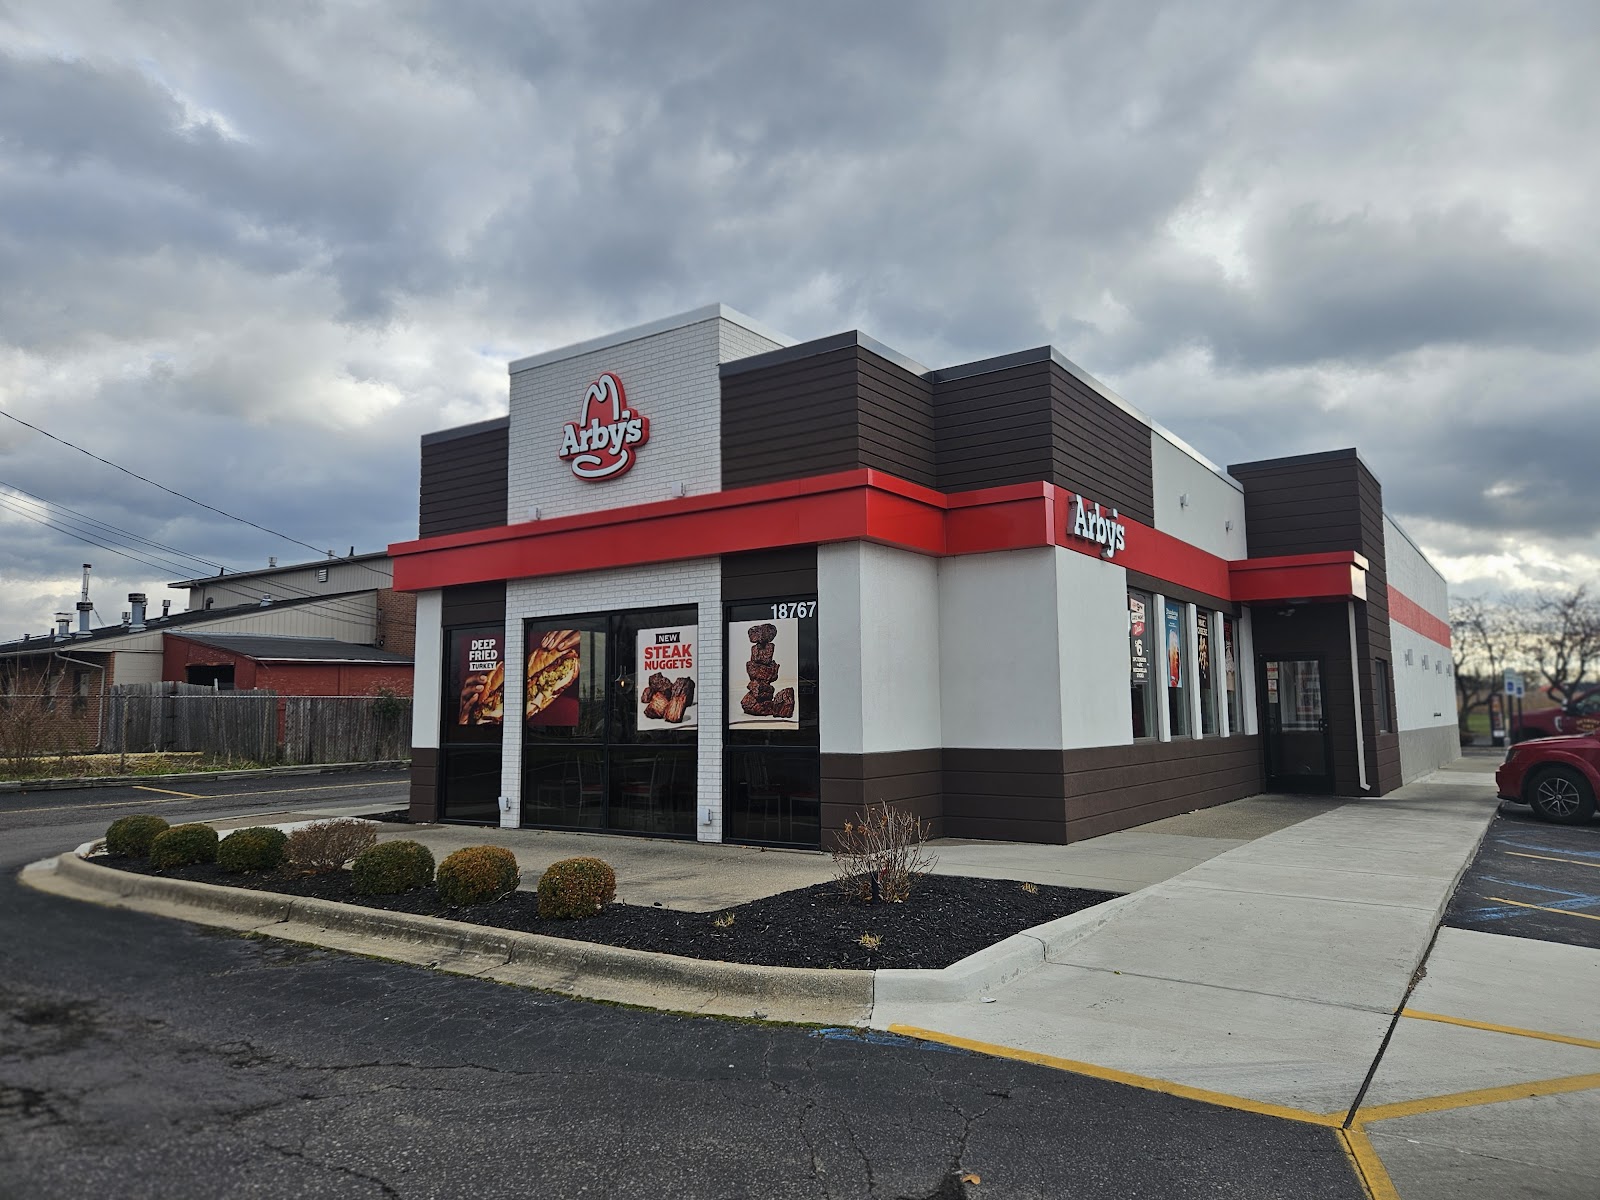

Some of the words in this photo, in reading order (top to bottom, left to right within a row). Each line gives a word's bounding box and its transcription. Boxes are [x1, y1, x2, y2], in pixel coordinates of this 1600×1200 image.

[559, 409, 642, 457] Arby's
[1073, 494, 1125, 558] Arby's
[770, 601, 817, 620] 18767
[471, 638, 496, 651] DEEP
[658, 634, 678, 643] NEW
[469, 649, 498, 661] FRIED
[644, 644, 692, 659] STEAK
[471, 662, 495, 670] TURKEY
[644, 658, 693, 671] NUGGETS
